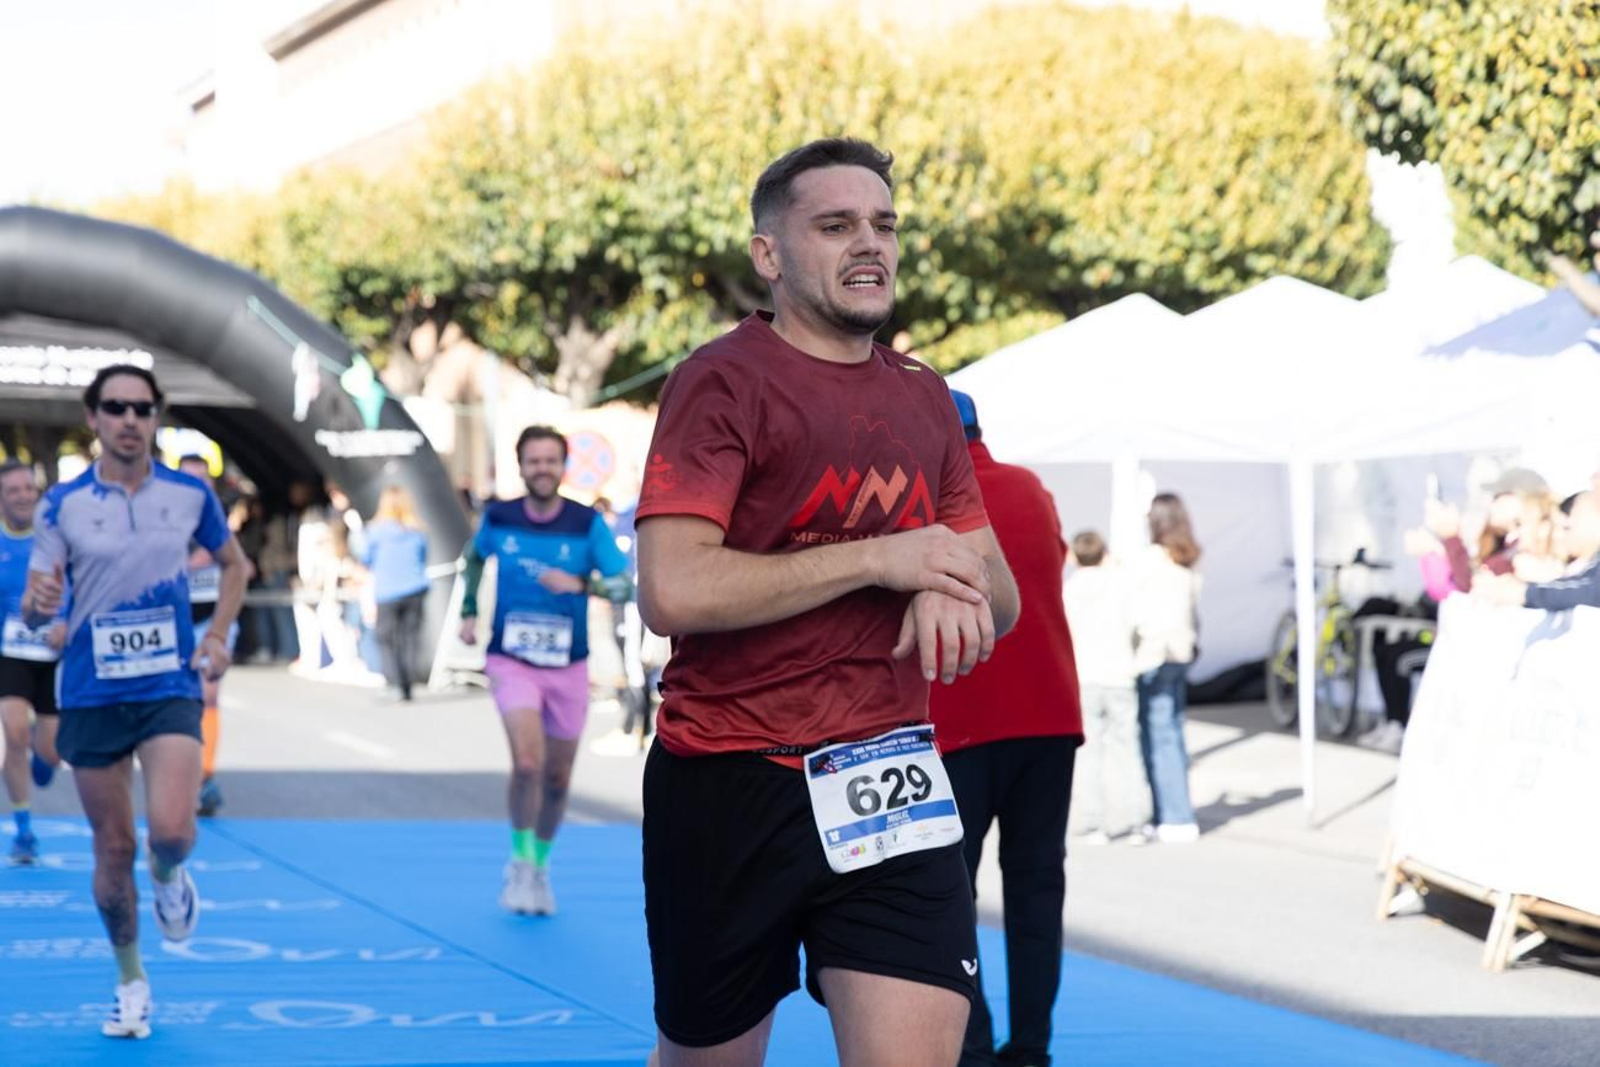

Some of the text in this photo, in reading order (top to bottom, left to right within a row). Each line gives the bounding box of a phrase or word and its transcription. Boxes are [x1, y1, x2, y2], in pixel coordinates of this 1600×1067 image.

[789, 531, 851, 544] MEDIA
[109, 627, 162, 653] 904
[846, 763, 933, 817] 629
